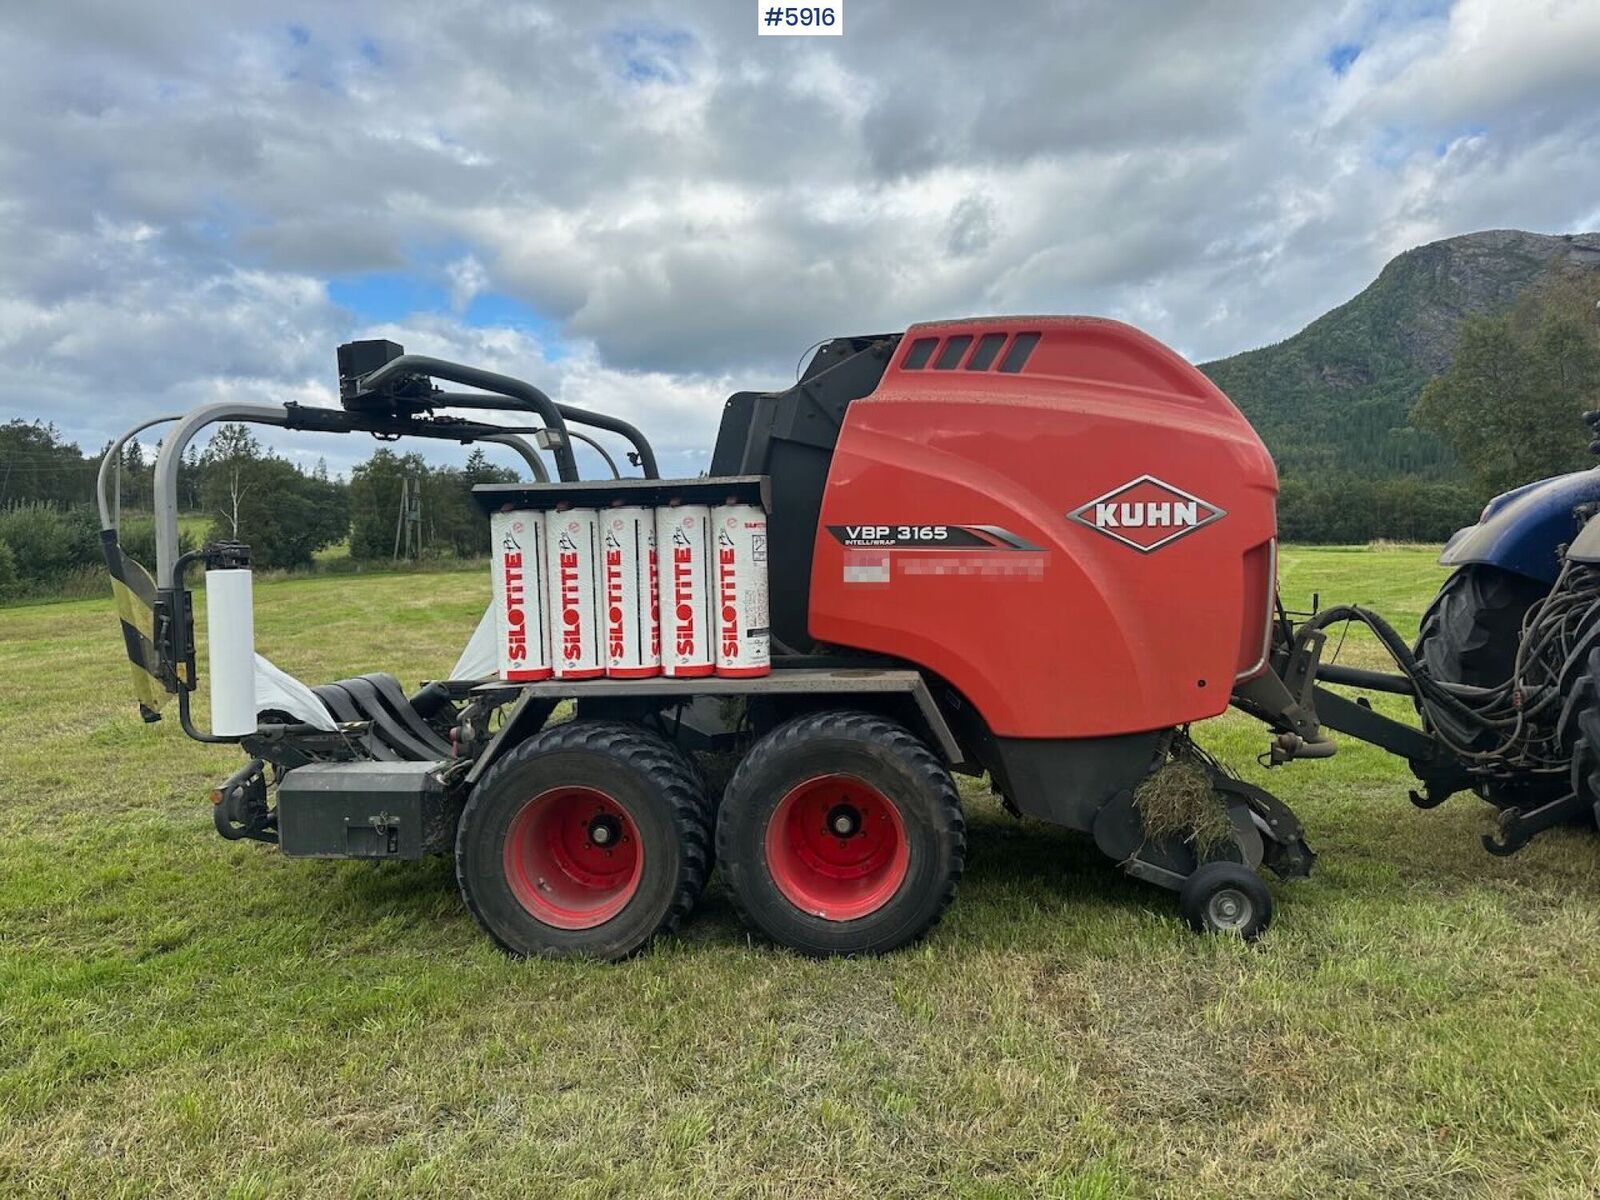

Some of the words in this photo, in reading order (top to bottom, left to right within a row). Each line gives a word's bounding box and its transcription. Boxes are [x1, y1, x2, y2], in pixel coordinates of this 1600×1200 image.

[1095, 502, 1197, 528] KUHN
[845, 525, 890, 540] VBP
[897, 525, 949, 540] 3165
